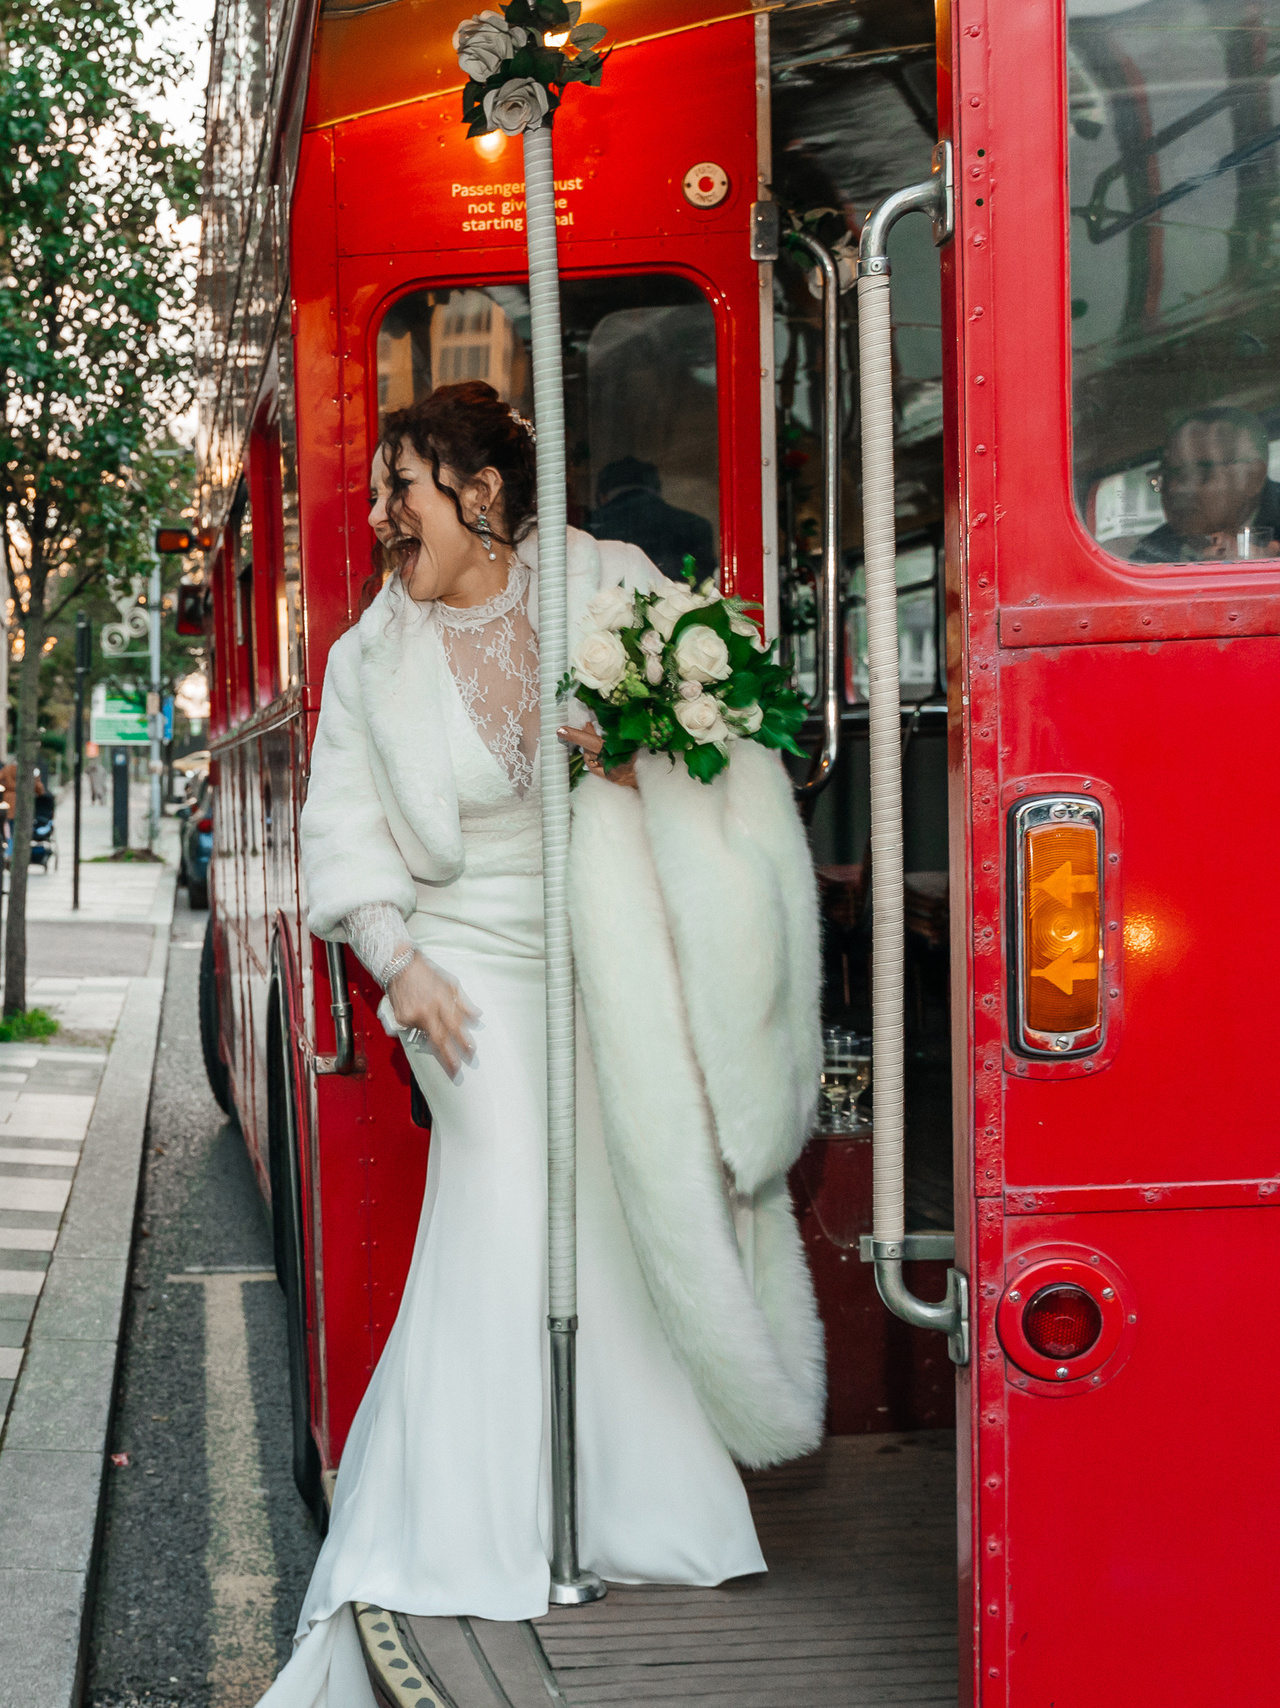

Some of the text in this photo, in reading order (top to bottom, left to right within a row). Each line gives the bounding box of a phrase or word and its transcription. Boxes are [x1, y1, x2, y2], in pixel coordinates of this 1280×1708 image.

[452, 182, 526, 197] Passenger
[468, 201, 495, 214] not
[462, 216, 524, 232] starting
